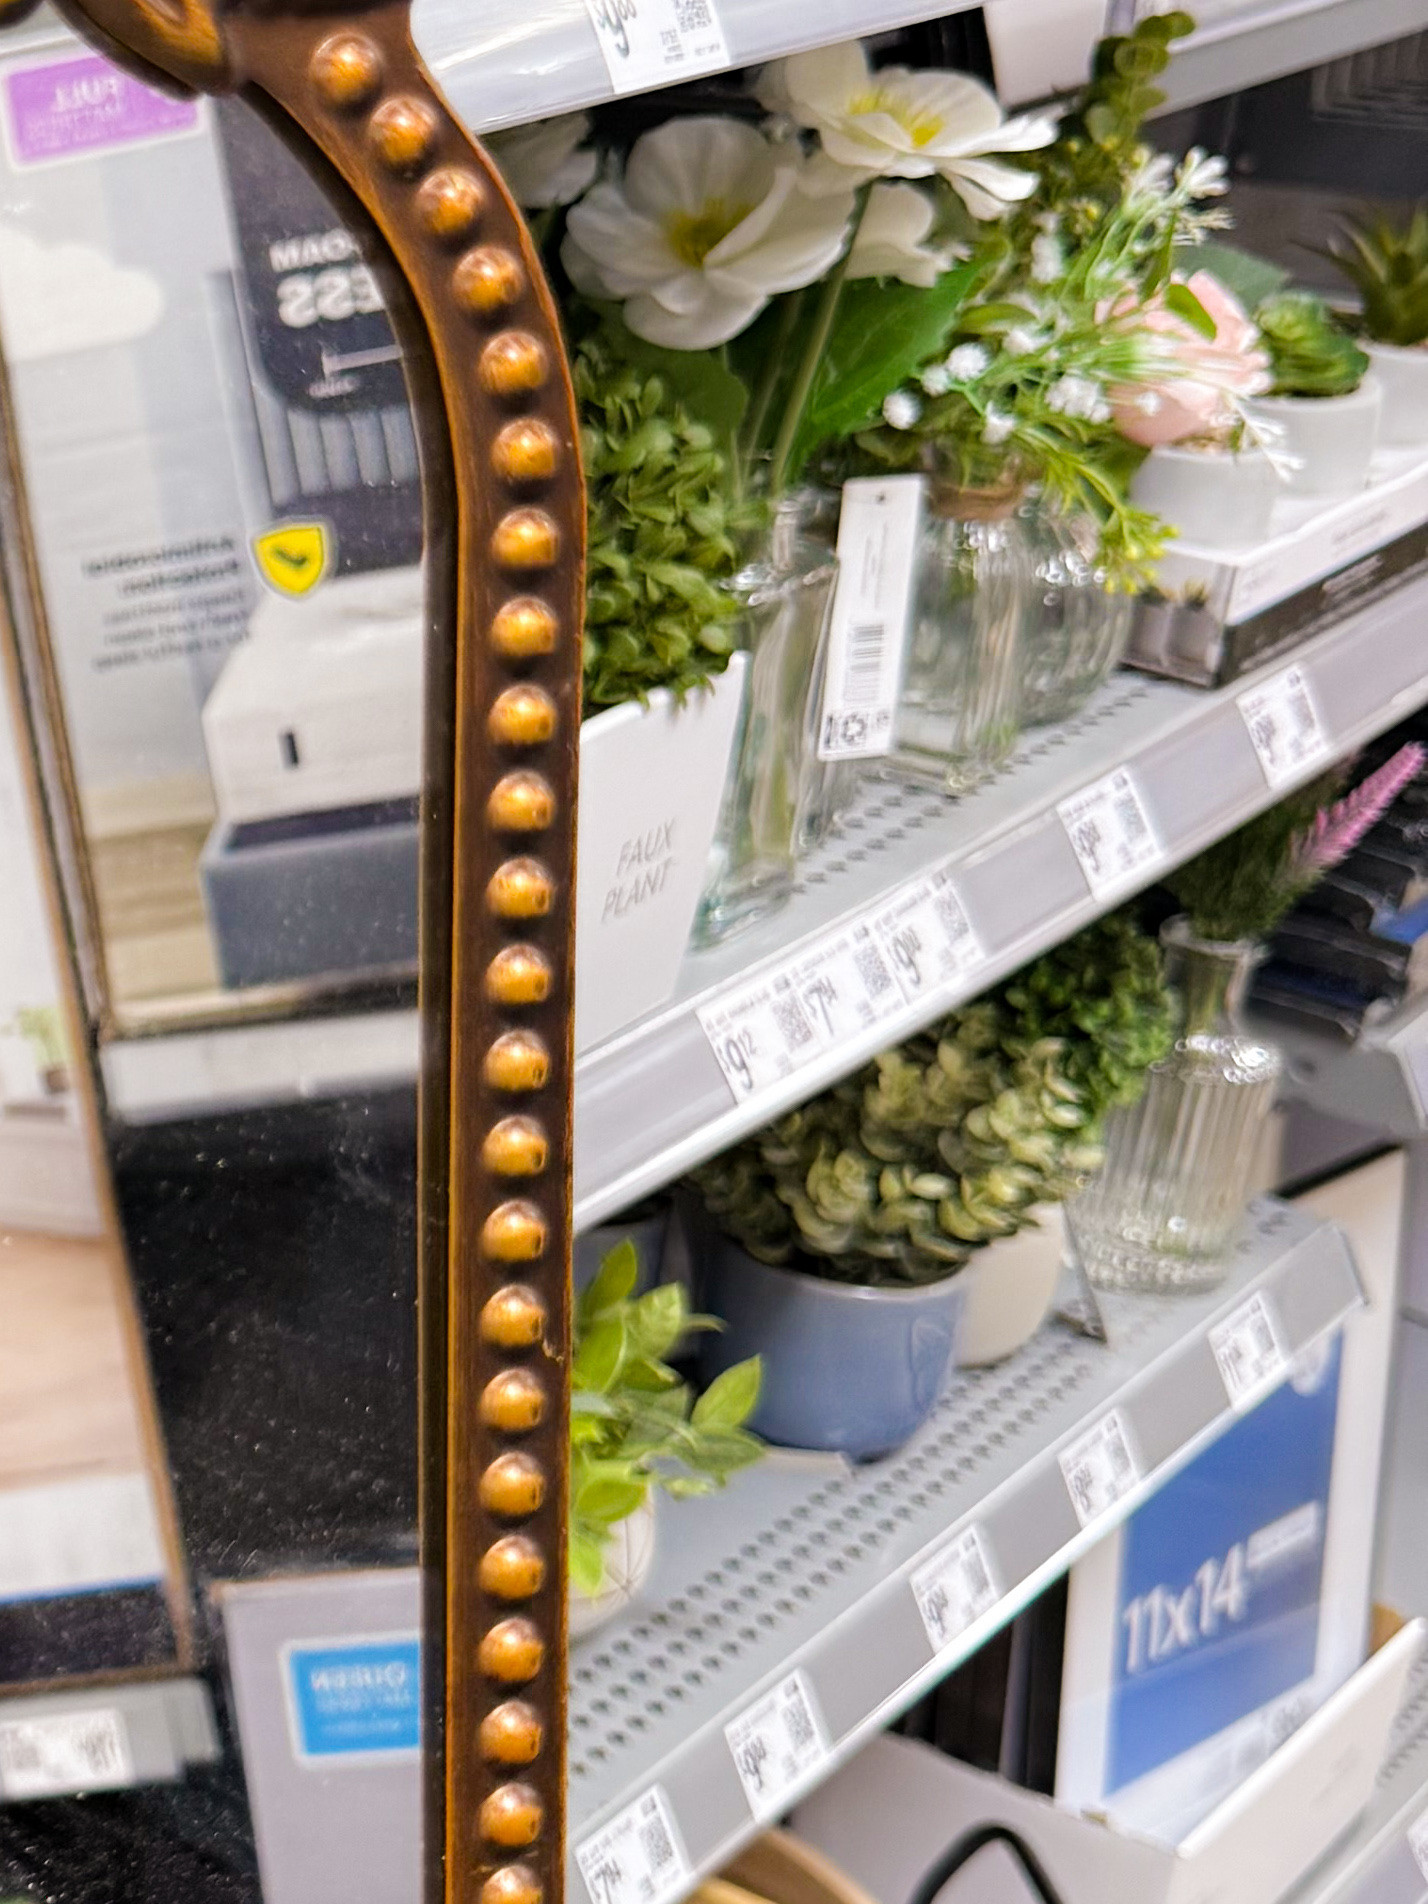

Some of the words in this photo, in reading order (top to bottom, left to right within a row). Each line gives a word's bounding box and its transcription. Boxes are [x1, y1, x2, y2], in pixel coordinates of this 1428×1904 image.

[617, 818, 675, 876] FAUX
[601, 856, 675, 924] PLANT
[1123, 1542, 1253, 1676] 11x14
